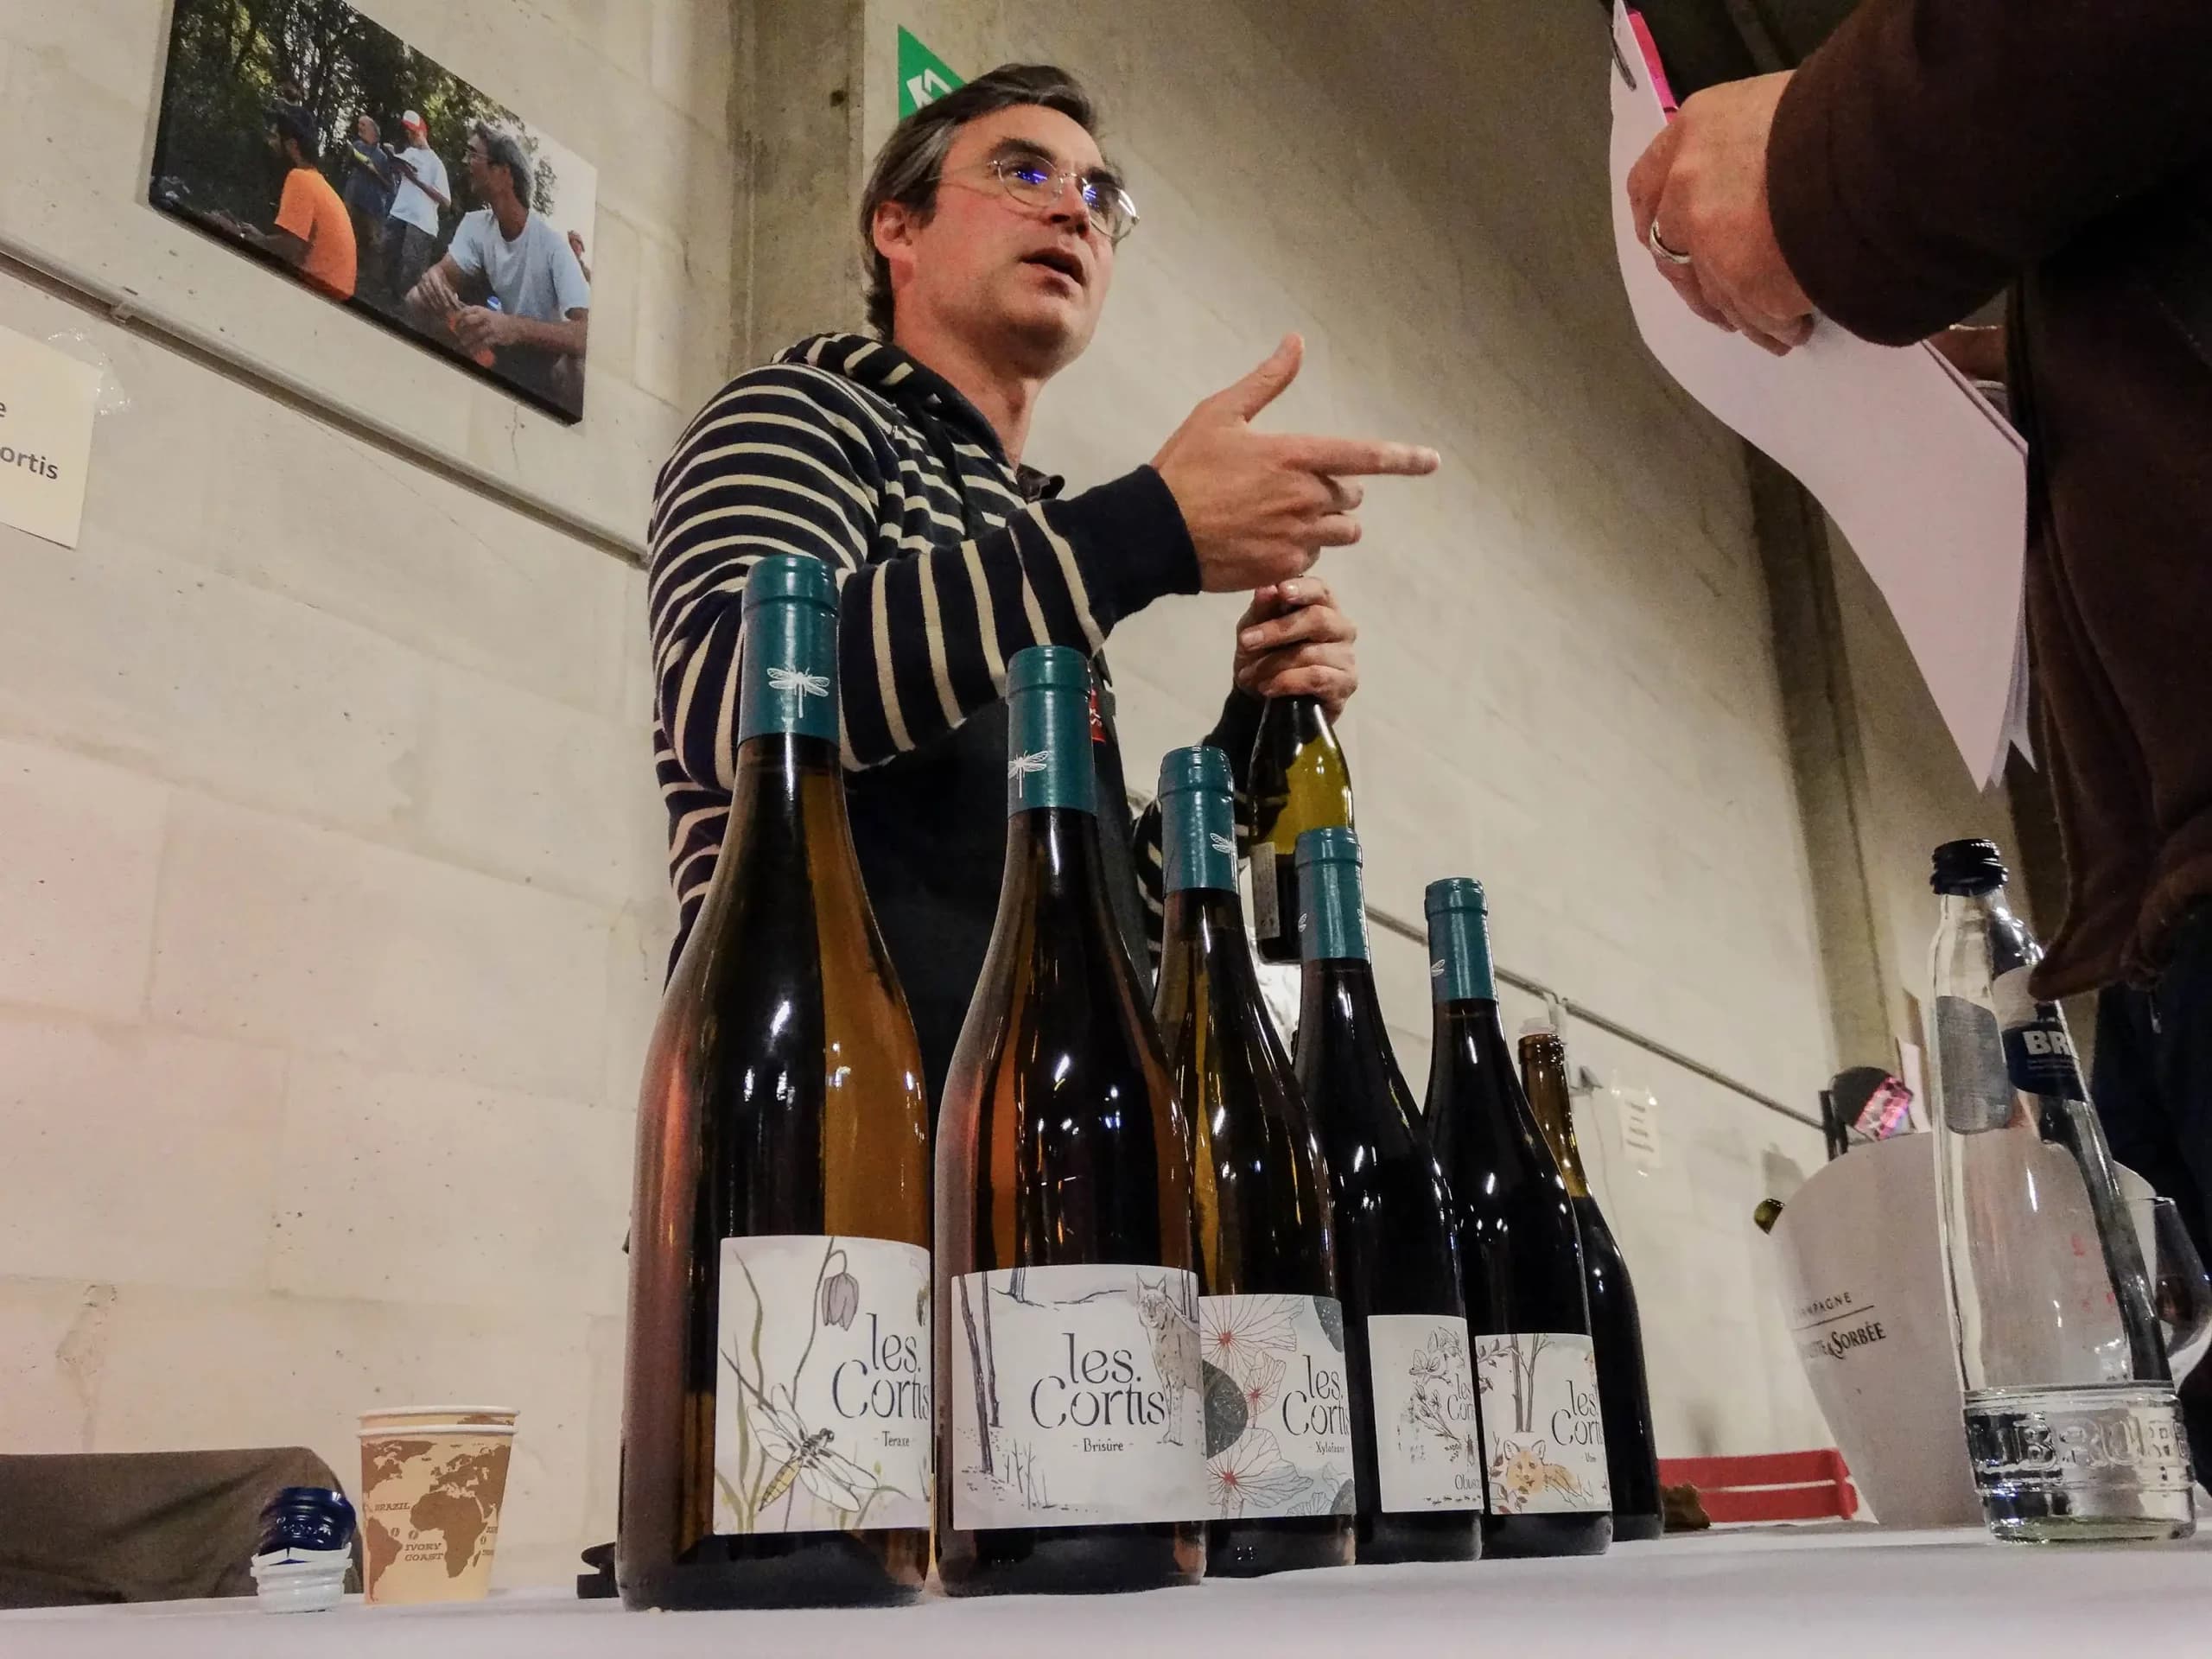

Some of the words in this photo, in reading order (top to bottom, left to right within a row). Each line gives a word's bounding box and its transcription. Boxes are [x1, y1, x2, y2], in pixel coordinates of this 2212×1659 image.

[832, 1359, 930, 1420] Cortis
[1030, 1375, 1166, 1429] Cortis
[373, 1502, 411, 1512] BRAZIL
[404, 1541, 442, 1552] IVORY
